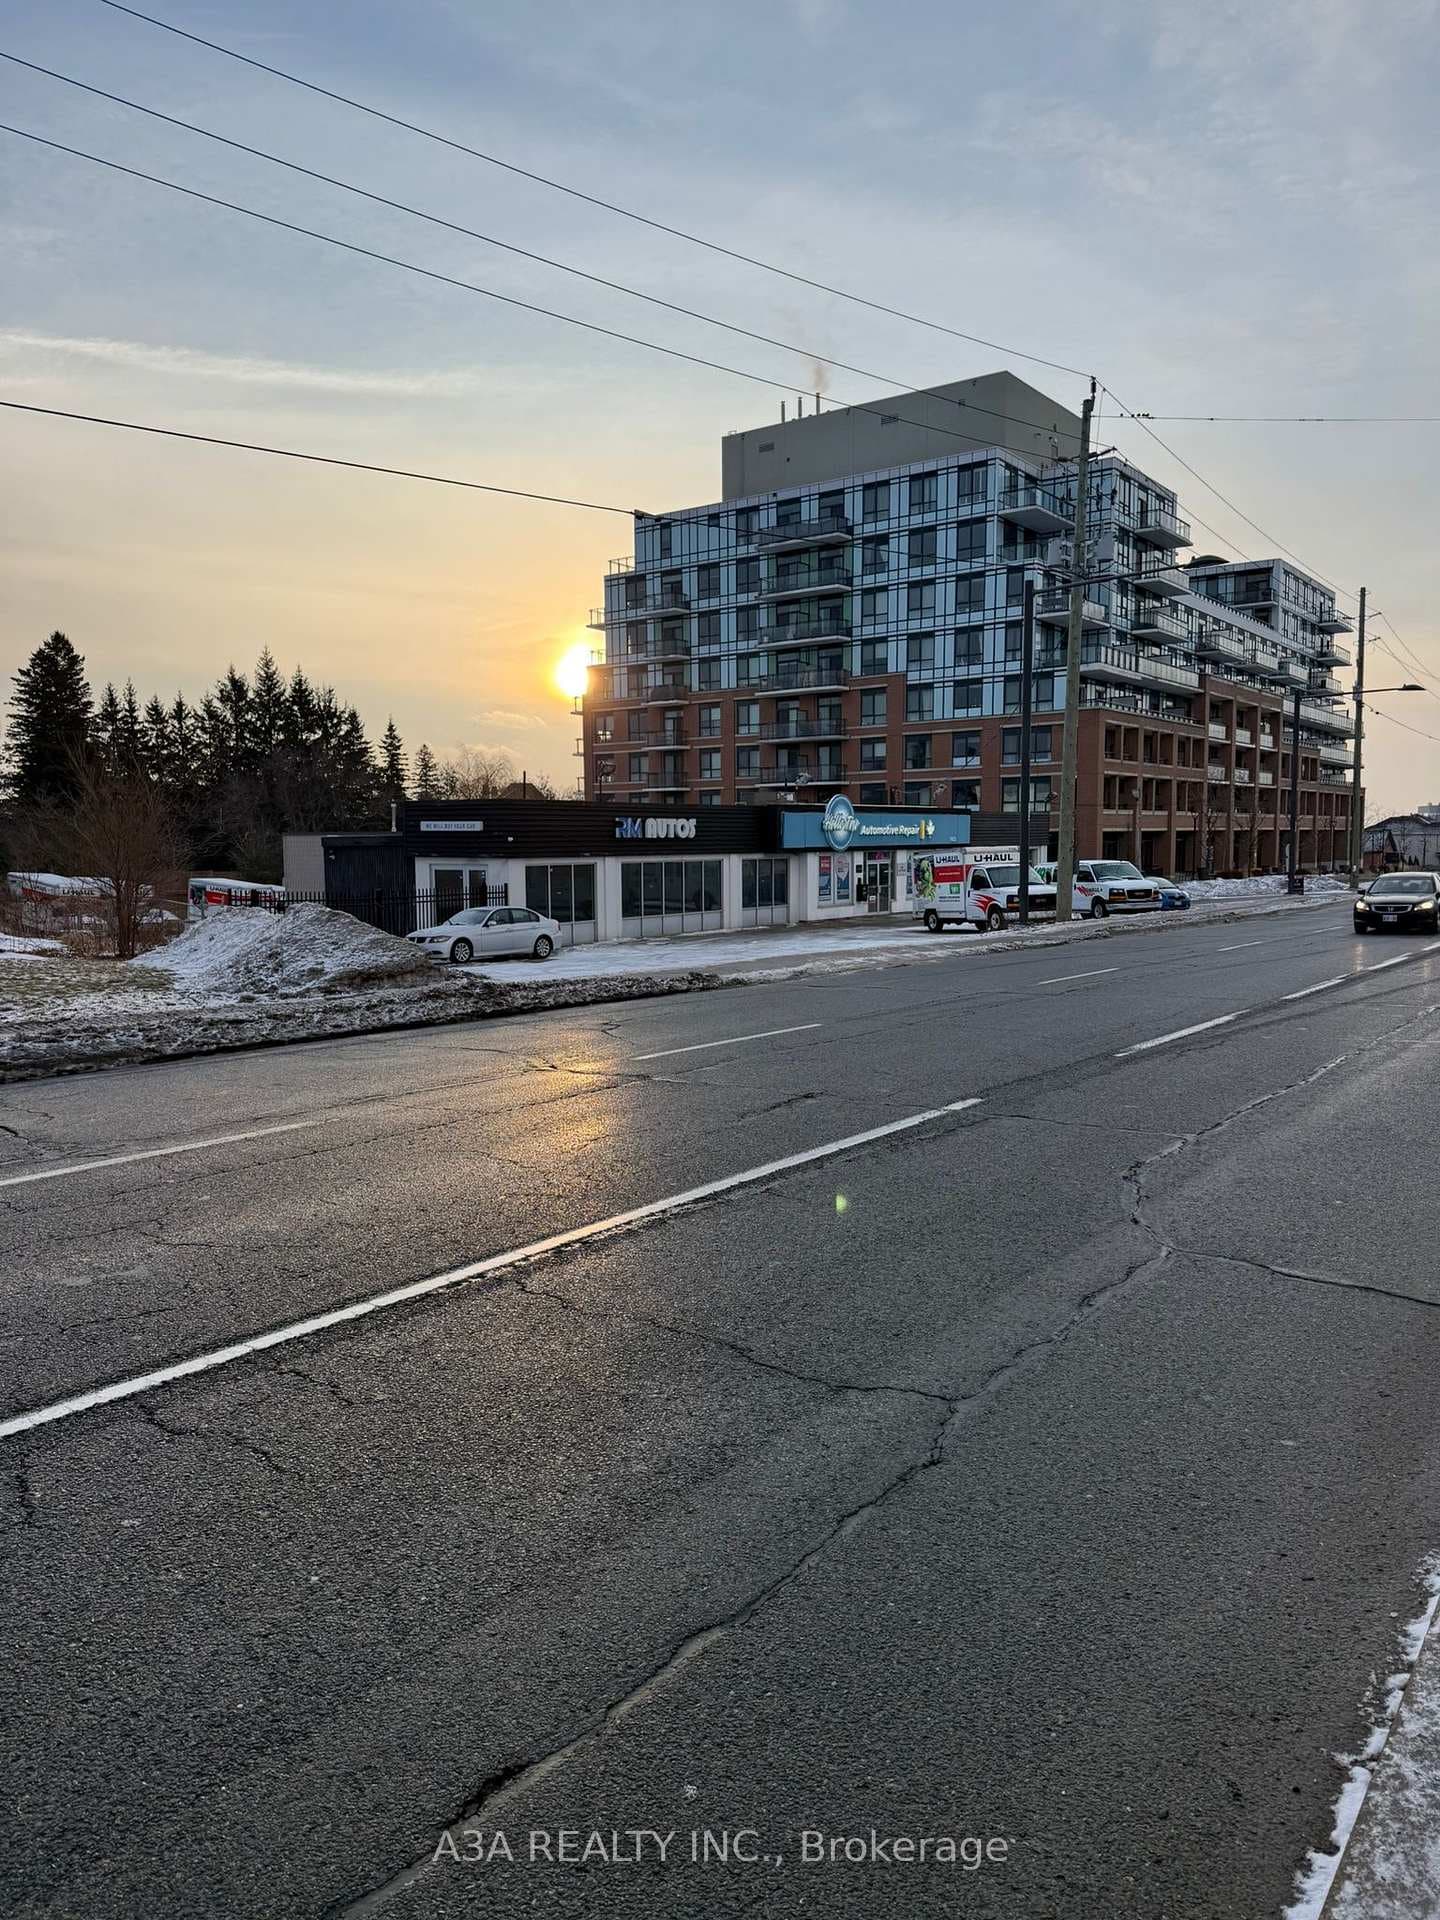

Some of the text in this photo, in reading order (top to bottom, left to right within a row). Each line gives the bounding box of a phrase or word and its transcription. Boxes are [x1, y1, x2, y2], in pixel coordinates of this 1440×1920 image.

[645, 817, 697, 839] AUTOS
[861, 824, 919, 837] Automotive Repair
[935, 855, 960, 864] U-HAUL
[973, 853, 1014, 863] U-HAUL
